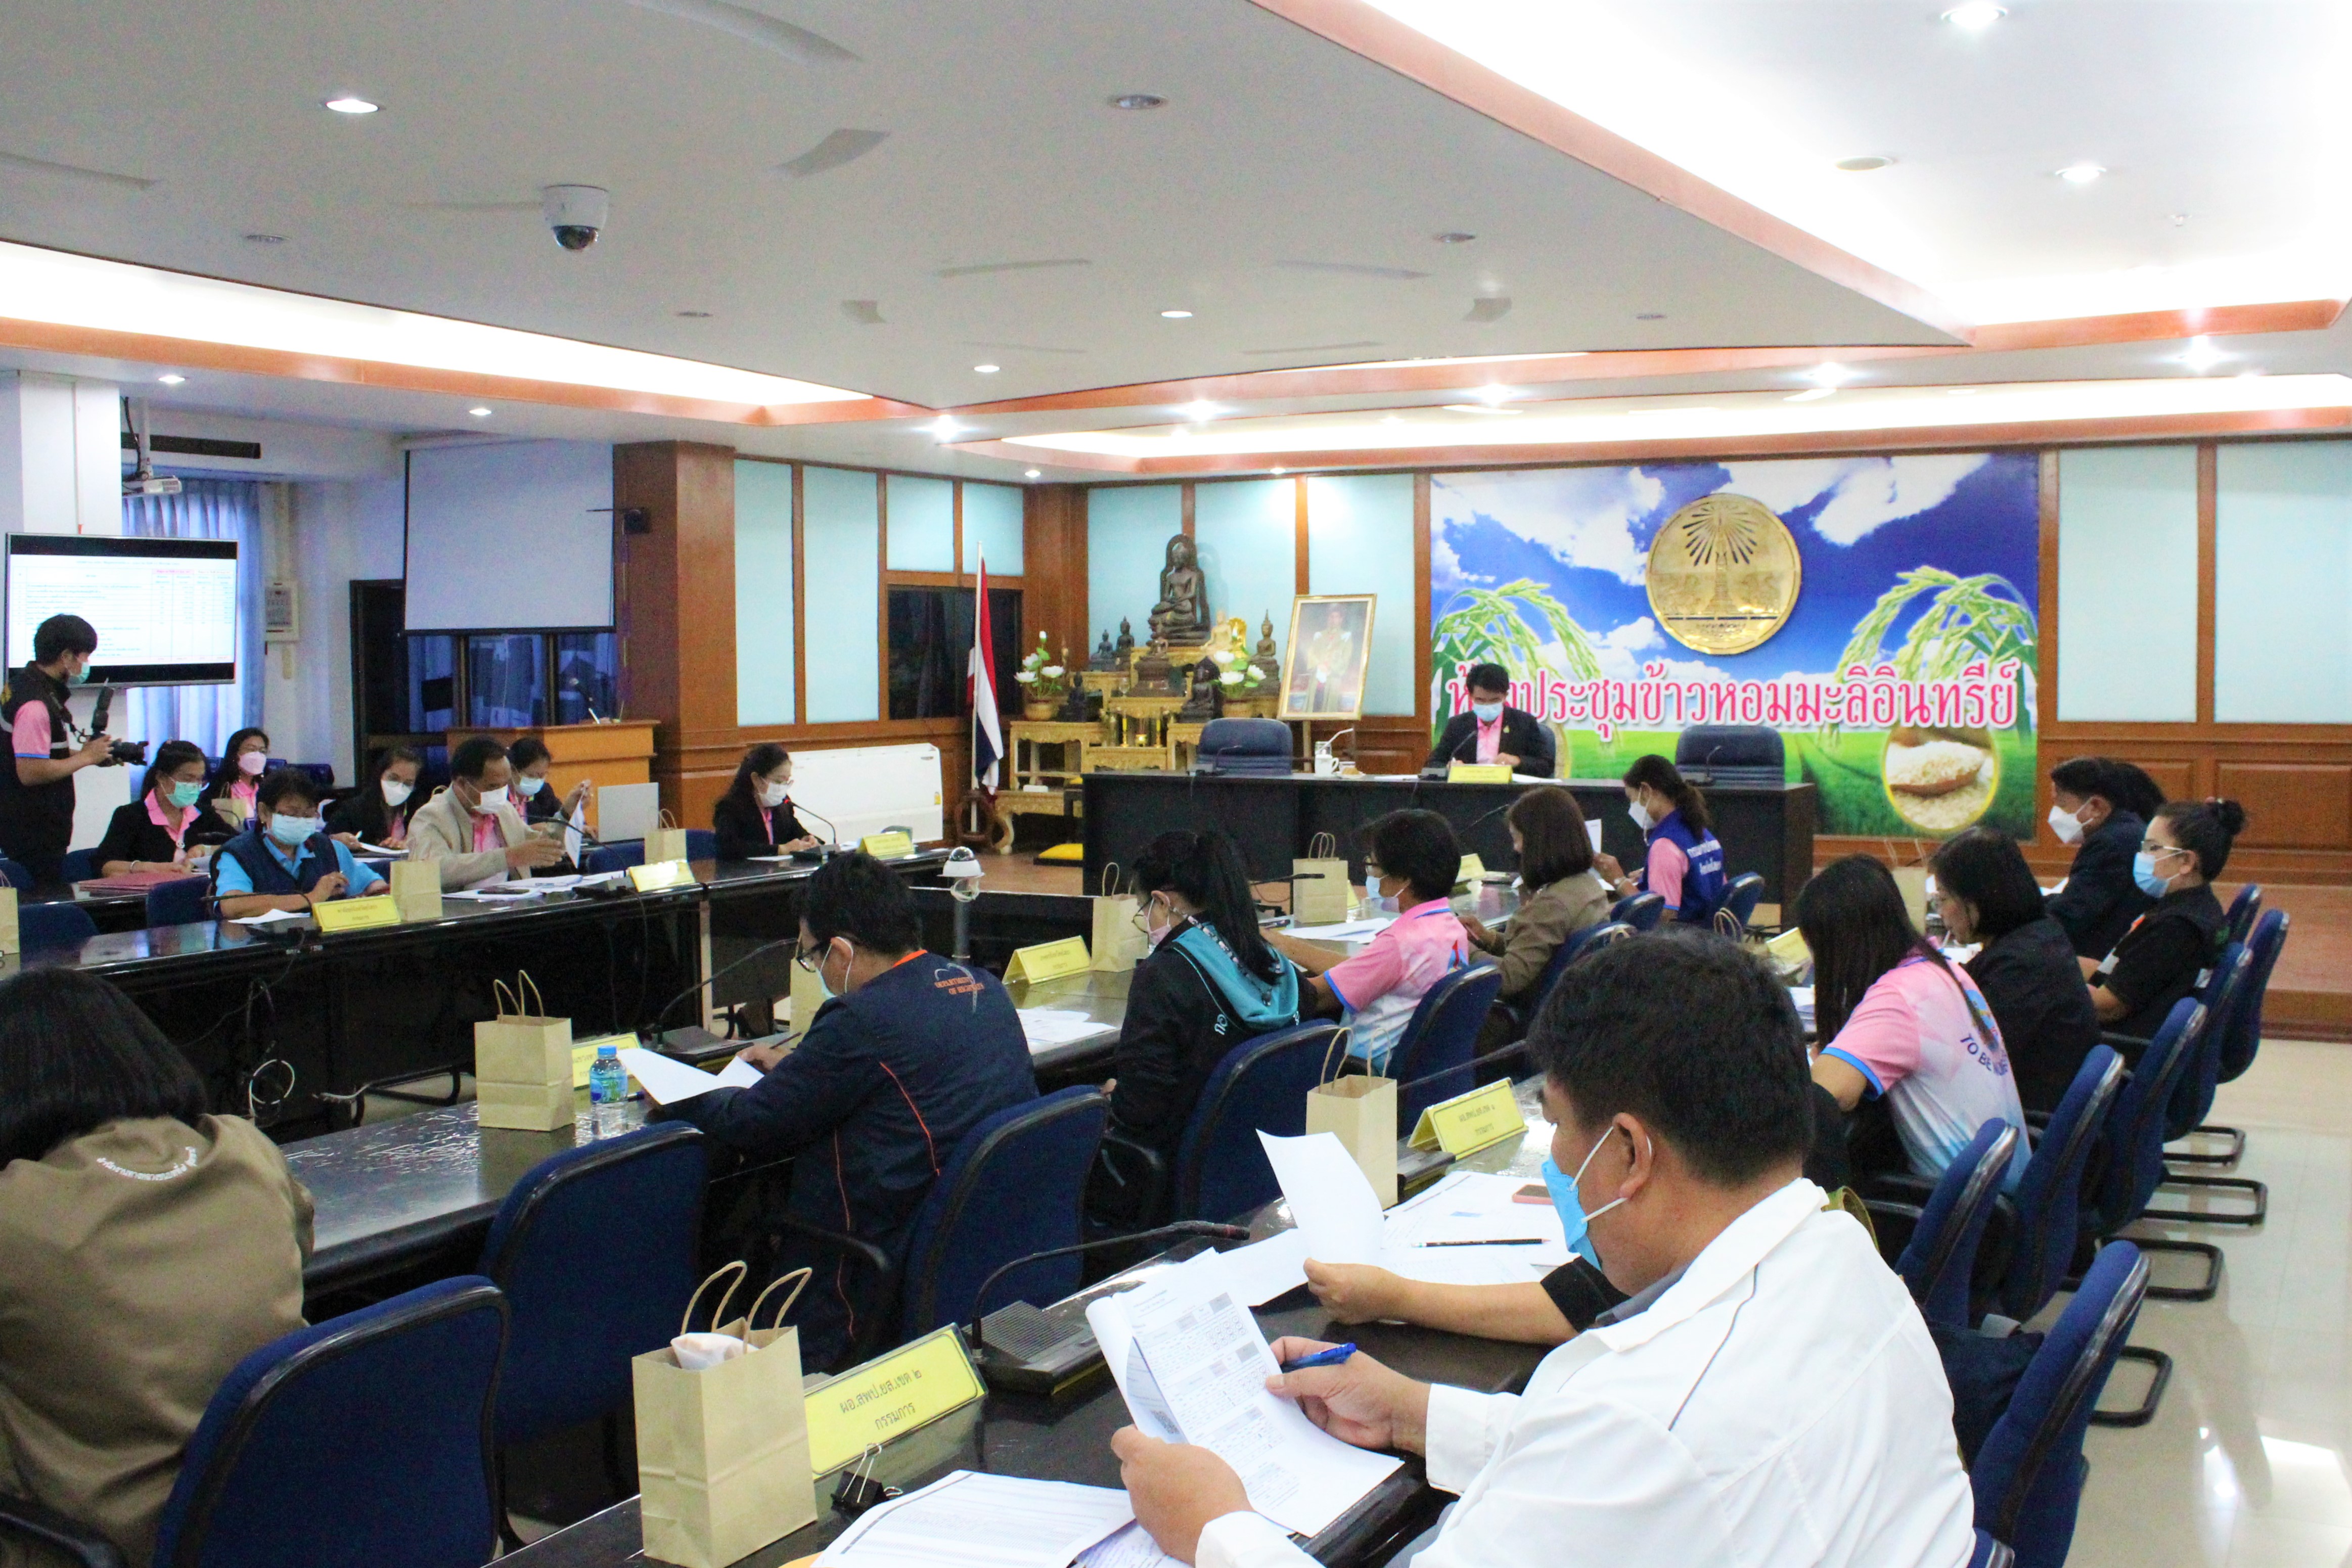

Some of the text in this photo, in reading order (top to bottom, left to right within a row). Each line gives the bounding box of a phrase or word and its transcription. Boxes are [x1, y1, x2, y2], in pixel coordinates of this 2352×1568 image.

[1449, 660, 2018, 739] ห้งประชุมข้าวหอมมะลิอินทรีย์
[1960, 1033, 1993, 1072] TO BE
[875, 1402, 916, 1431] กรรมการ
